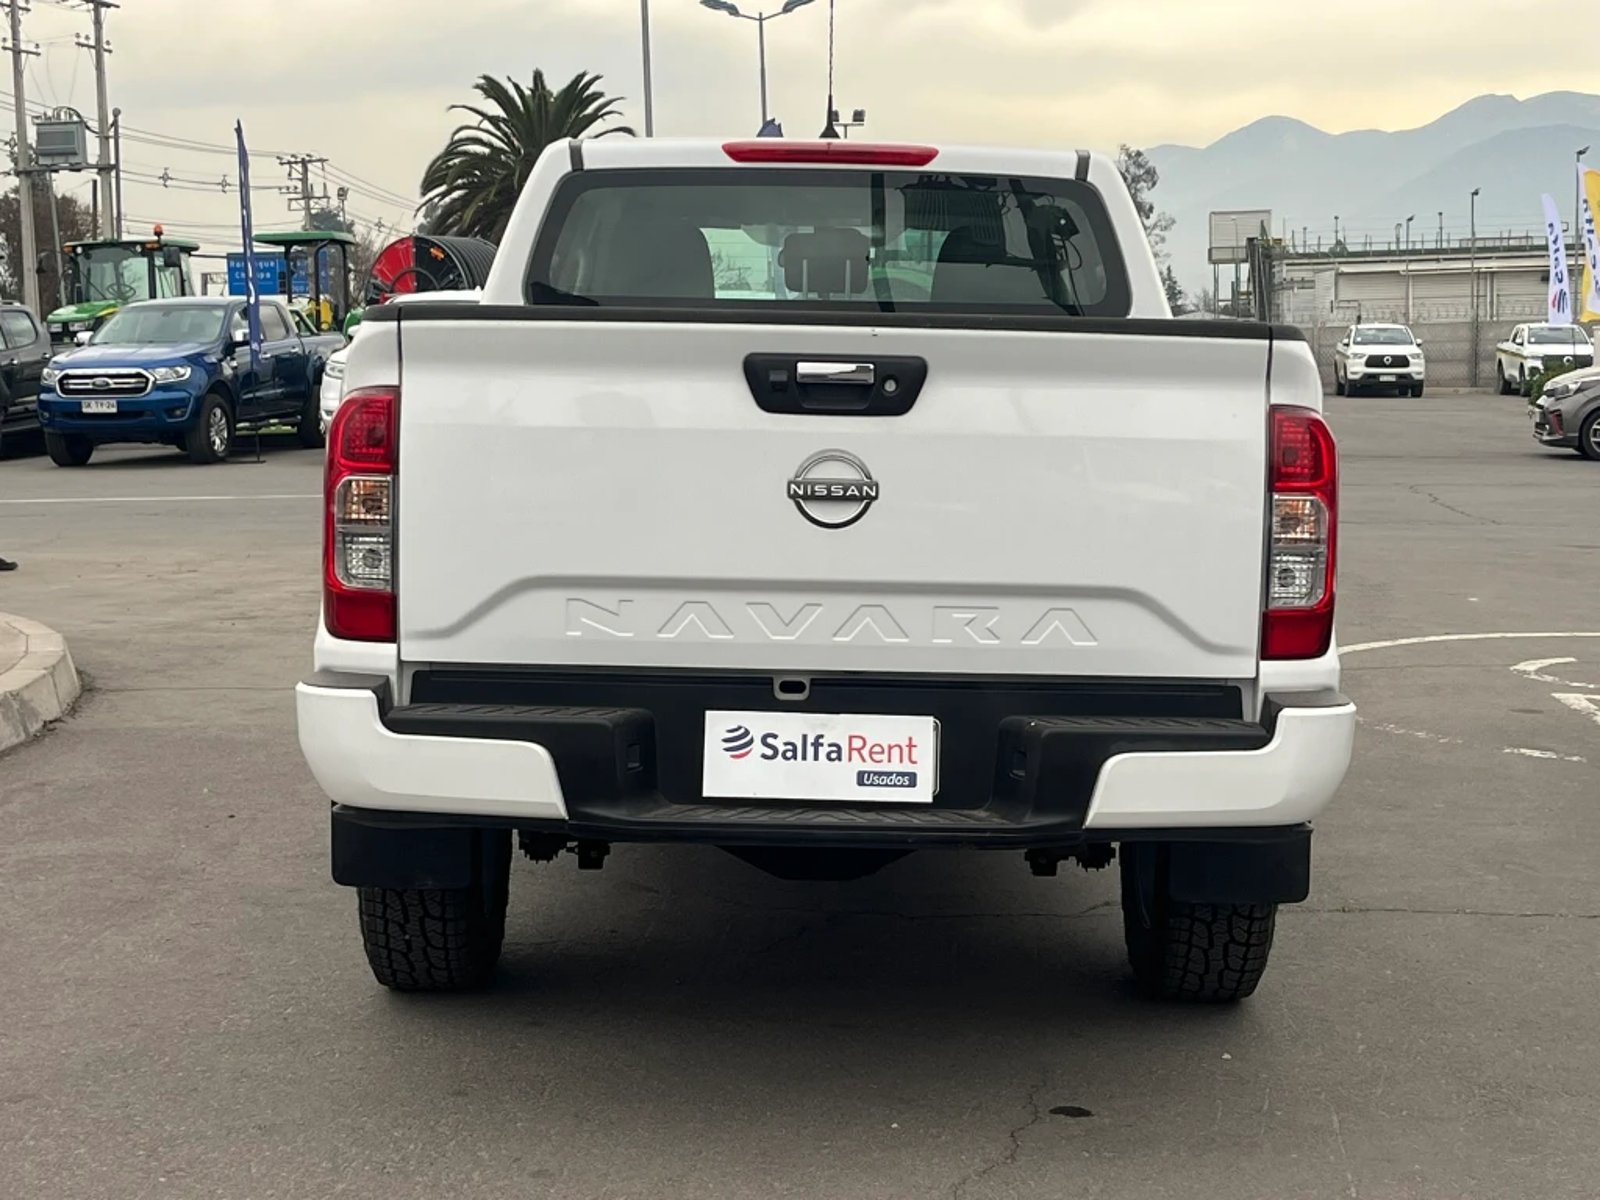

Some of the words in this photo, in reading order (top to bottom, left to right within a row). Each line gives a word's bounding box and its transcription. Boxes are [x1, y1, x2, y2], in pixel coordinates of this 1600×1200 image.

[789, 483, 876, 497] NISSAN
[565, 598, 1098, 647] NAVARA
[863, 772, 910, 787] Usados
